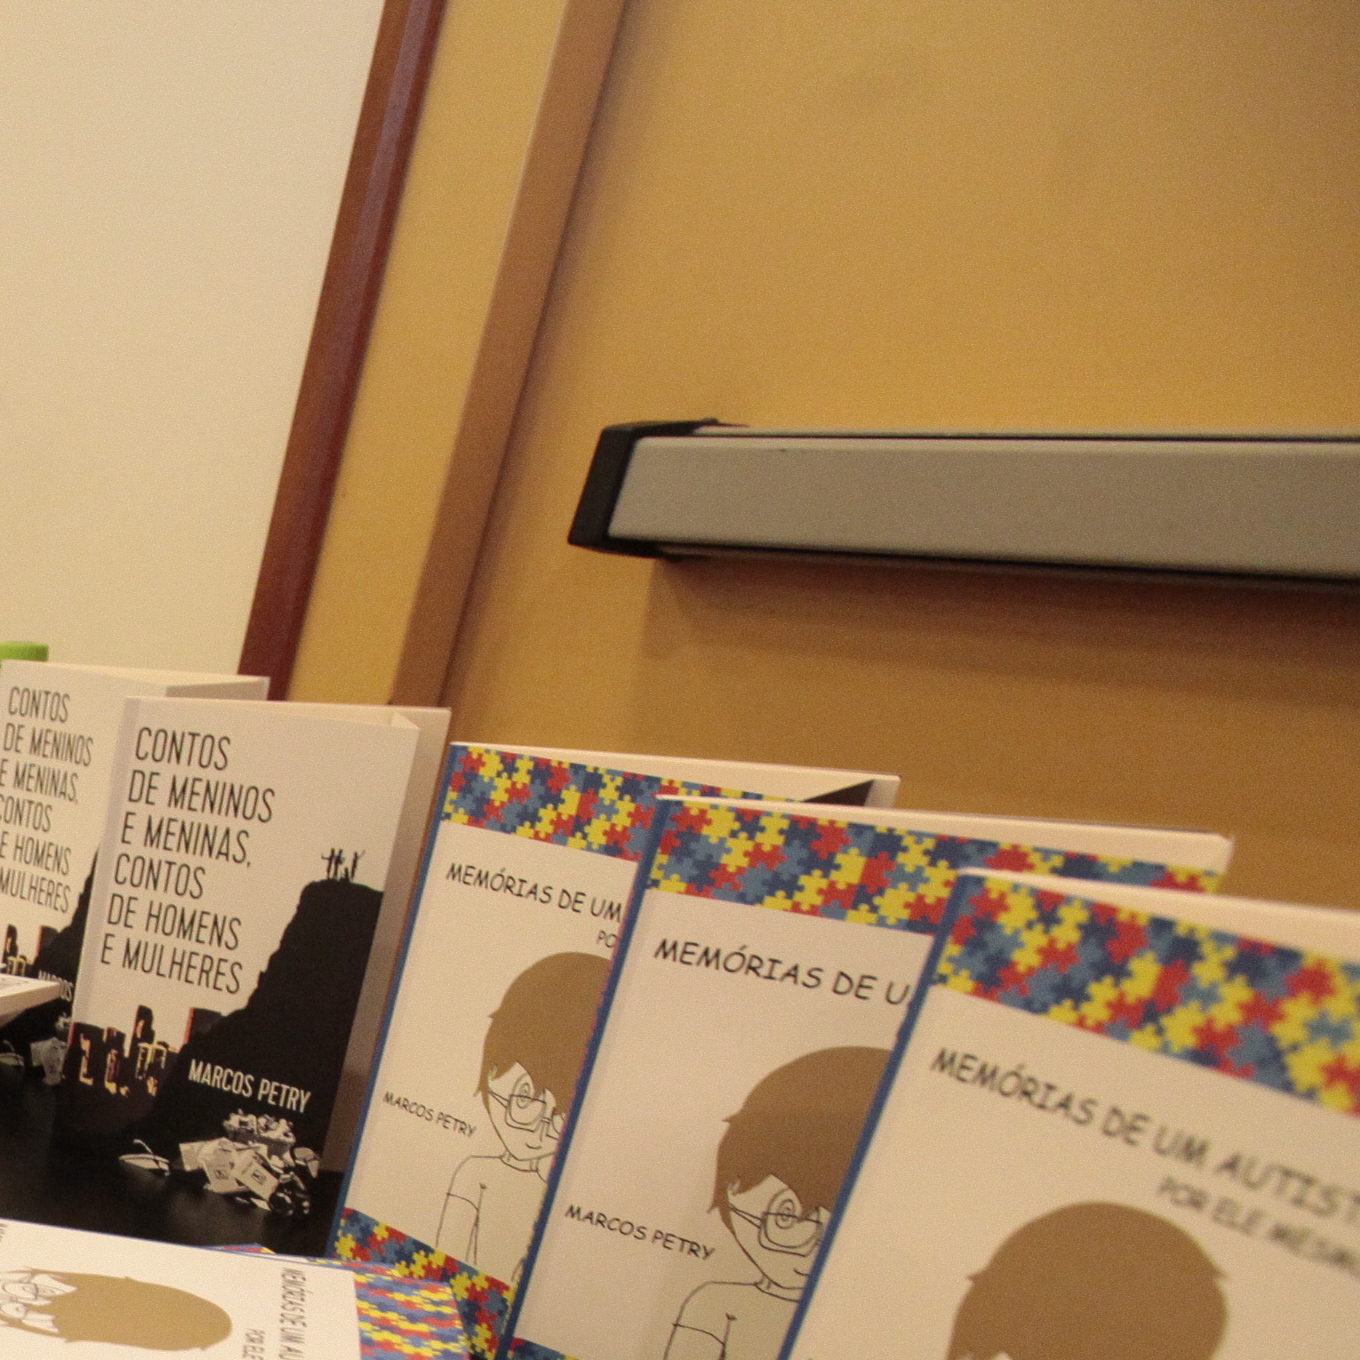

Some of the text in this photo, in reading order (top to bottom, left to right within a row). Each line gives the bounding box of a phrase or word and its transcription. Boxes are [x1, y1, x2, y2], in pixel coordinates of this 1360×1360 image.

[8, 686, 71, 723] CONTOS
[3, 722, 94, 767] DE MENINOS
[135, 726, 231, 771] CONTOS
[13, 760, 79, 804] MENINAS,
[128, 769, 275, 823] DE MENINOS
[13, 834, 72, 876] HOMENS
[121, 812, 251, 868] E MENINAS,
[114, 853, 206, 899] CONTOS
[446, 862, 623, 924] MEMÓRIAS DE UM
[108, 894, 241, 951] DE HOMENS
[101, 933, 243, 994] E MULHERES
[654, 938, 824, 989] MEMÓRIAS
[832, 970, 878, 1000] DE
[188, 1058, 312, 1114] MARCOS PETRY
[930, 1046, 1098, 1127] MEMÓRIAS
[1100, 1106, 1150, 1146] DE
[1153, 1125, 1211, 1170] UM
[383, 1090, 477, 1138] MARCOS PETRY
[565, 1204, 716, 1260] MARCOS PETRY
